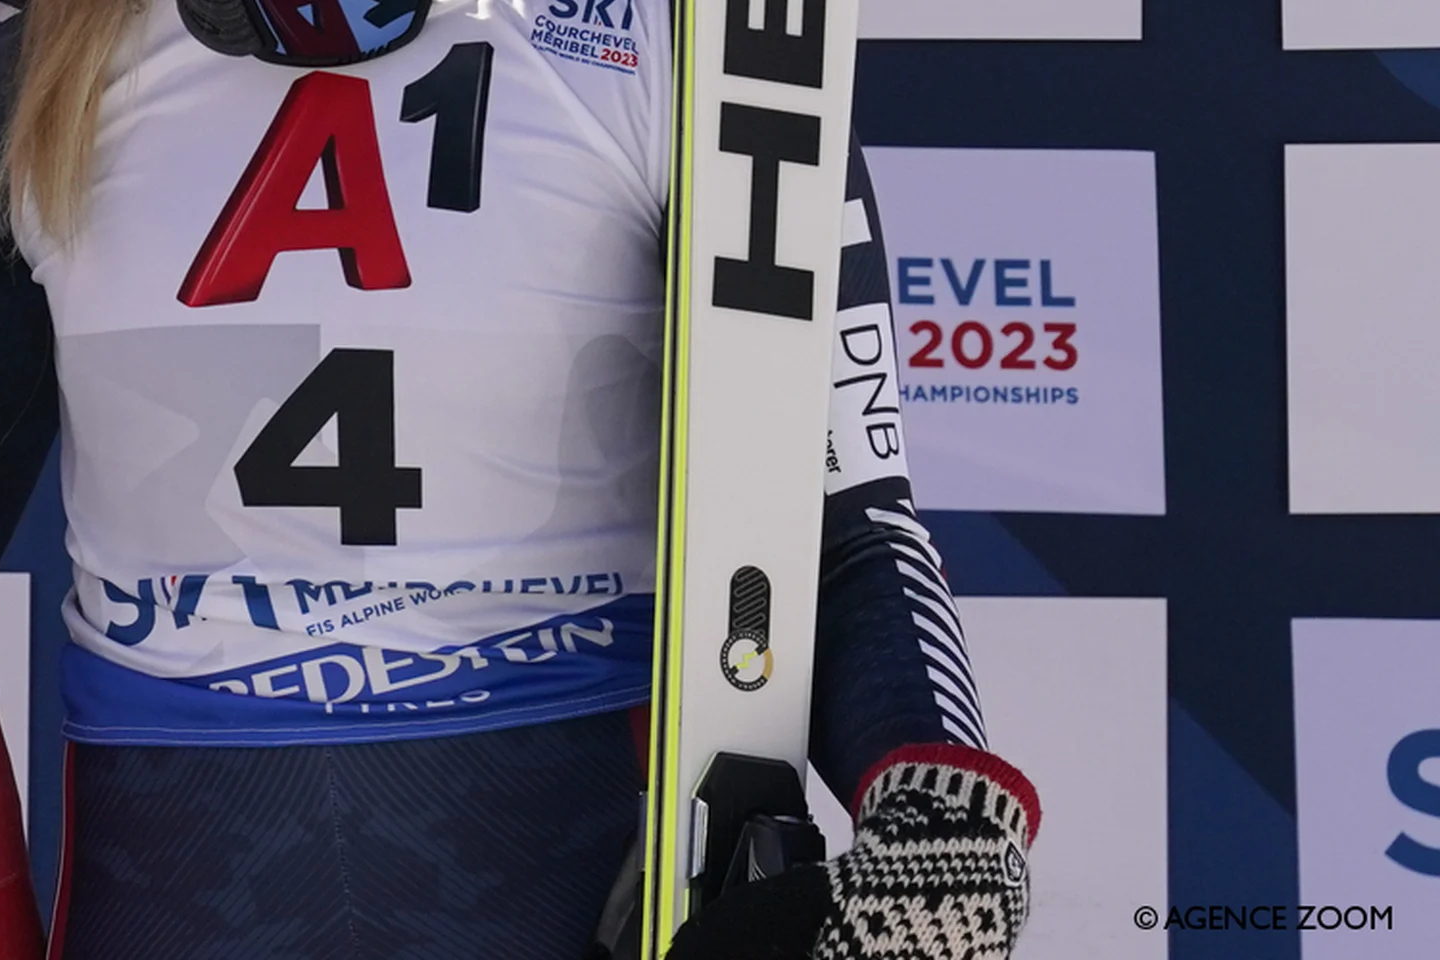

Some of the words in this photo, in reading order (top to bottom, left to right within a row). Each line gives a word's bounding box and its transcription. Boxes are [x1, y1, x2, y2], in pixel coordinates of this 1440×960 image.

[534, 14, 640, 56] COURCHEVEL
[600, 47, 639, 68] 2023
[176, 41, 495, 308] A1
[908, 319, 1079, 371] 2023
[833, 323, 900, 460] DNB
[899, 385, 1080, 405] HAMPIONSHIPS
[233, 347, 423, 547] 4
[306, 619, 336, 638] FIS
[340, 596, 406, 630] ALPINE
